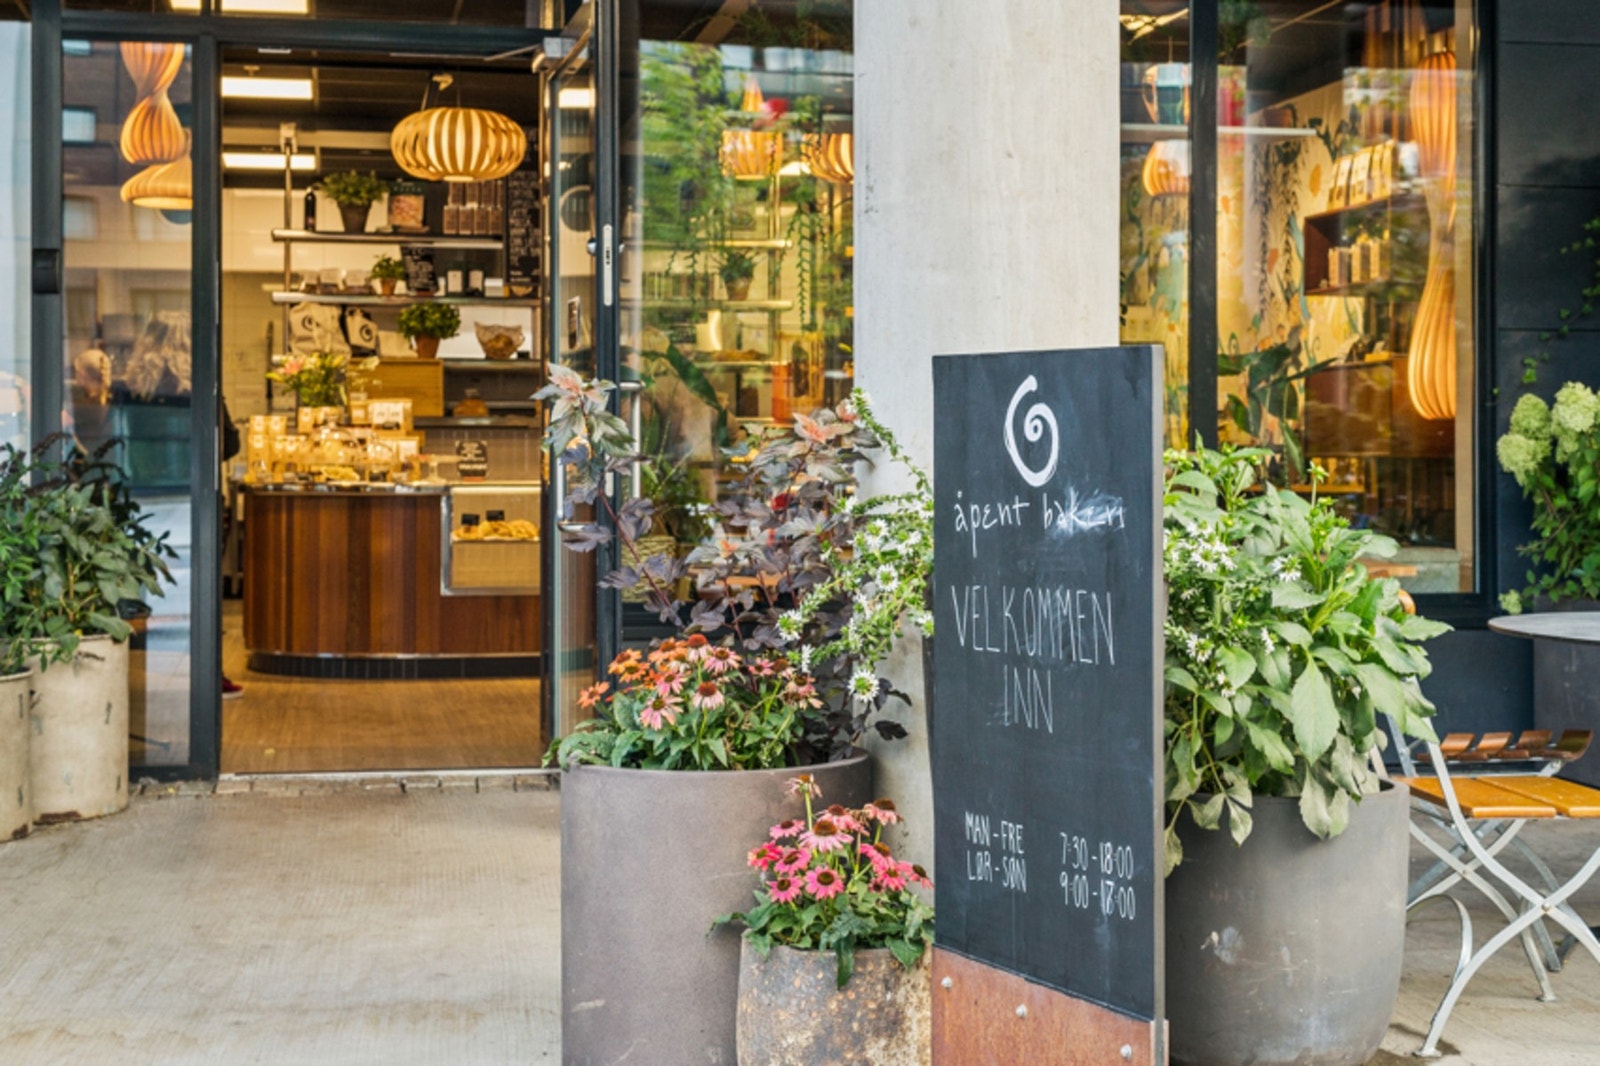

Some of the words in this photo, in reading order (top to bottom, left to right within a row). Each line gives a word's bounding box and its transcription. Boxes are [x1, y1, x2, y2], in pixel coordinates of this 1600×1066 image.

[954, 490, 1030, 558] åpent
[951, 584, 1115, 666] VELKOMMEN
[1004, 664, 1053, 733] INN
